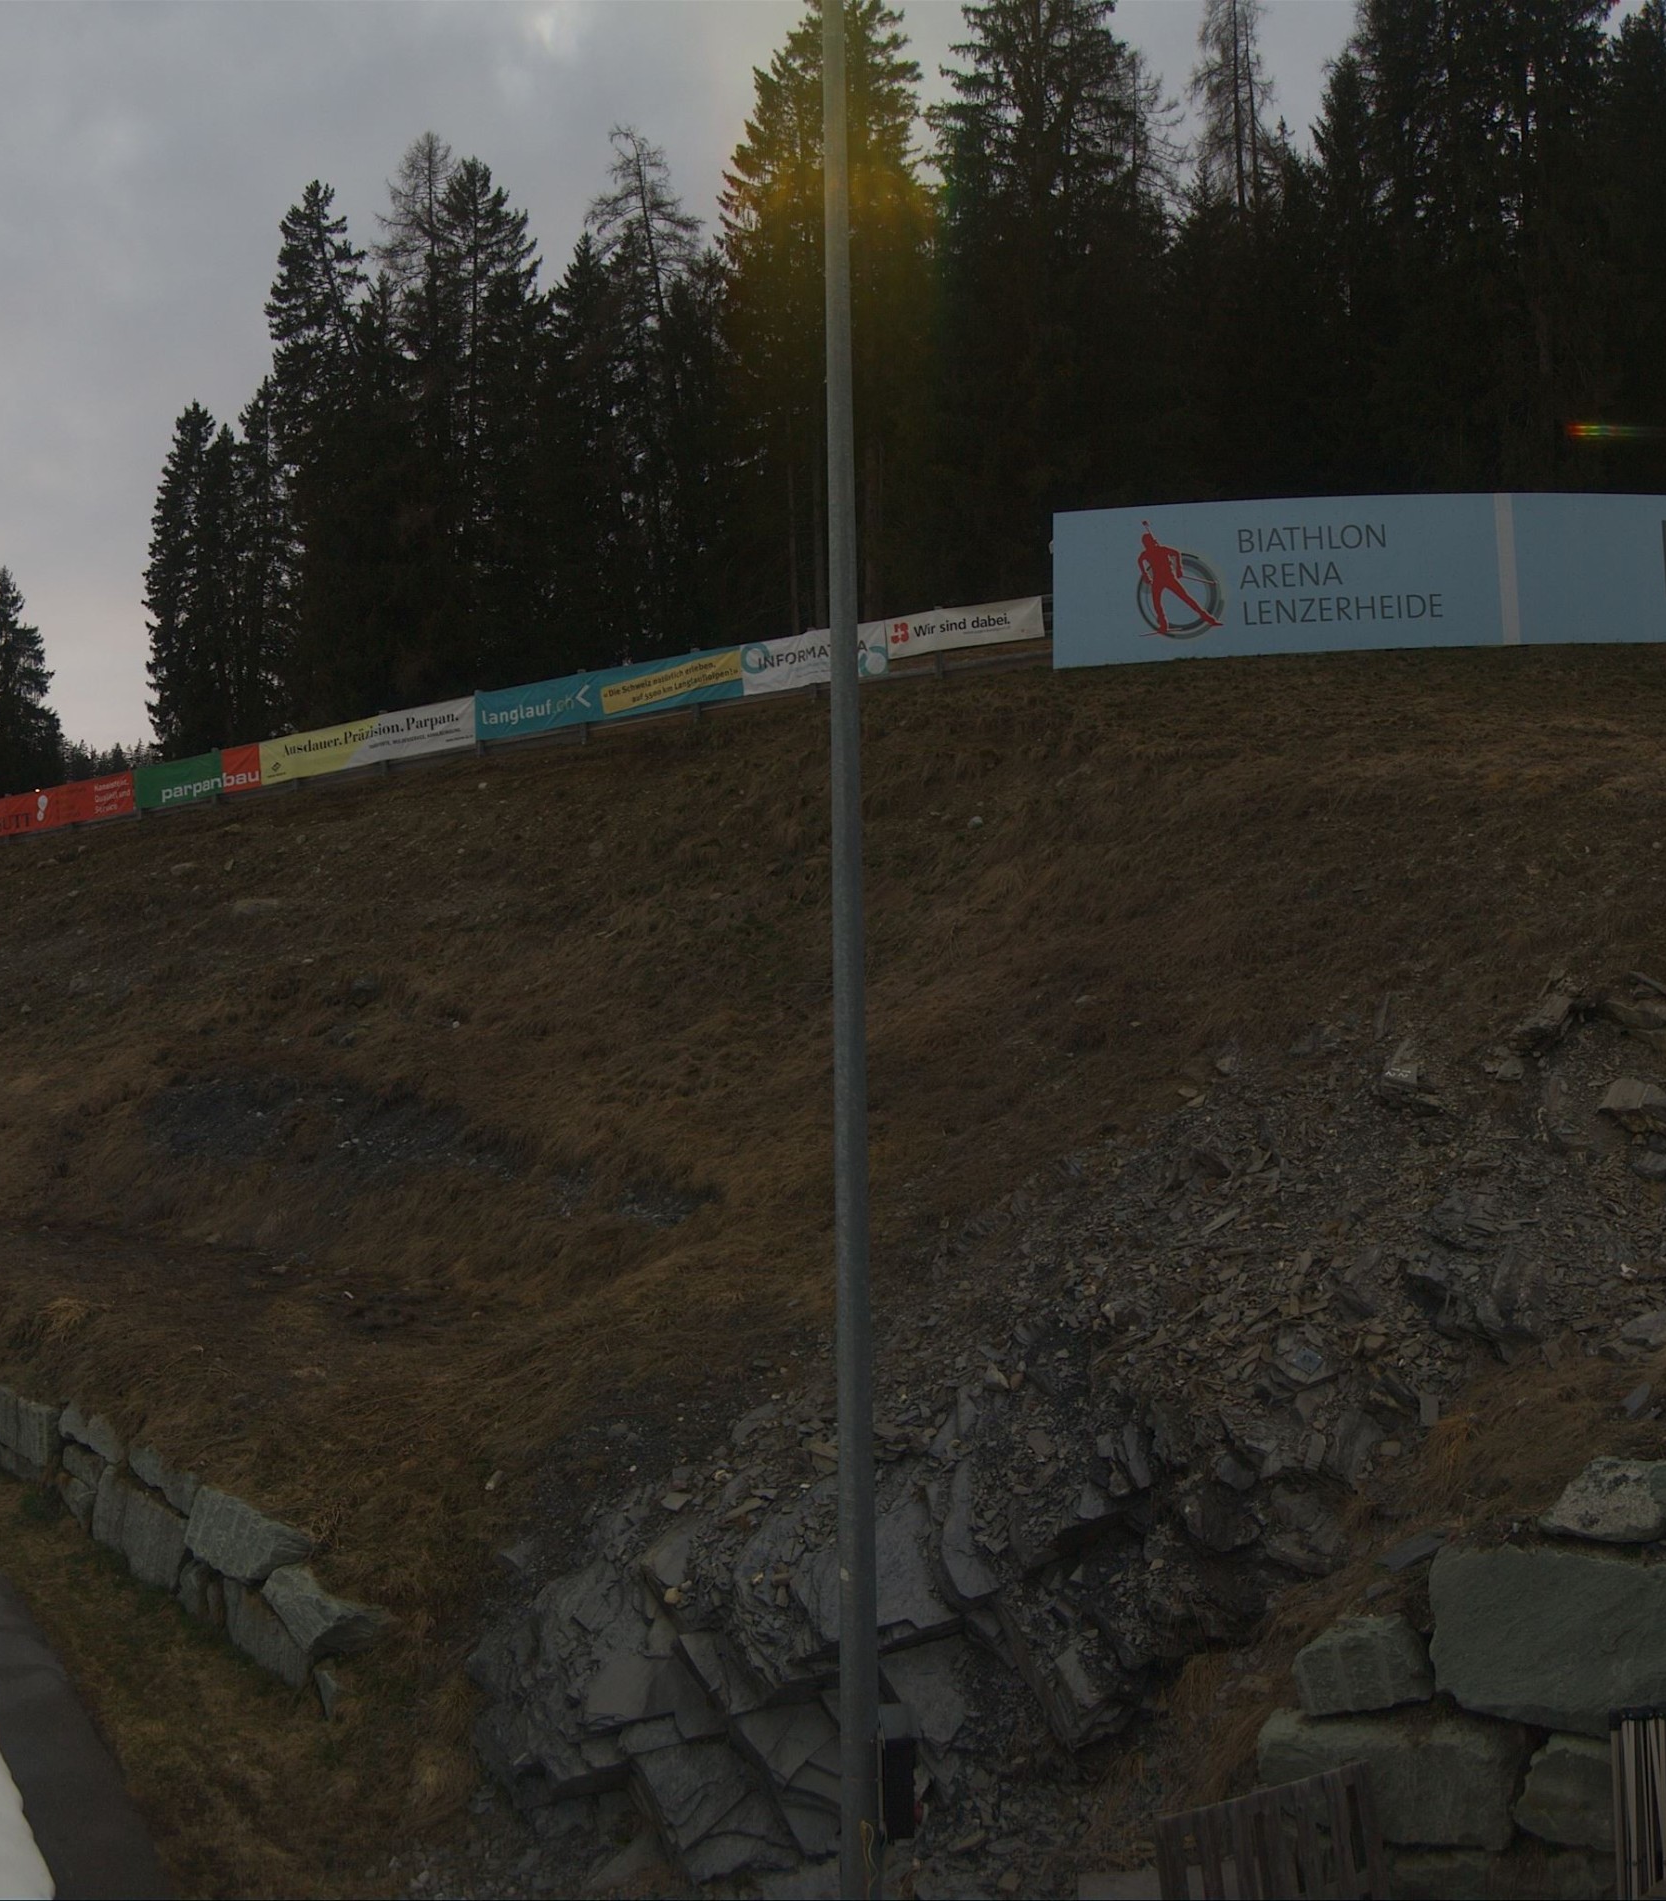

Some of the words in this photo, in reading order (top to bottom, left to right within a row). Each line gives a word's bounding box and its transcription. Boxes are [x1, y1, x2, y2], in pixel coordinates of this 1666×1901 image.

[1237, 524, 1386, 553] BIATHLON
[1240, 561, 1343, 589] ARENA
[1243, 594, 1443, 625] LENZERHEIDE
[914, 624, 936, 637] Wir
[940, 619, 966, 633] sind
[971, 613, 1011, 628] dabei.
[758, 640, 868, 670] INFORMAA
[622, 680, 651, 693] Schweiz
[406, 712, 459, 731] Parpan.
[161, 771, 259, 802] parpanbau
